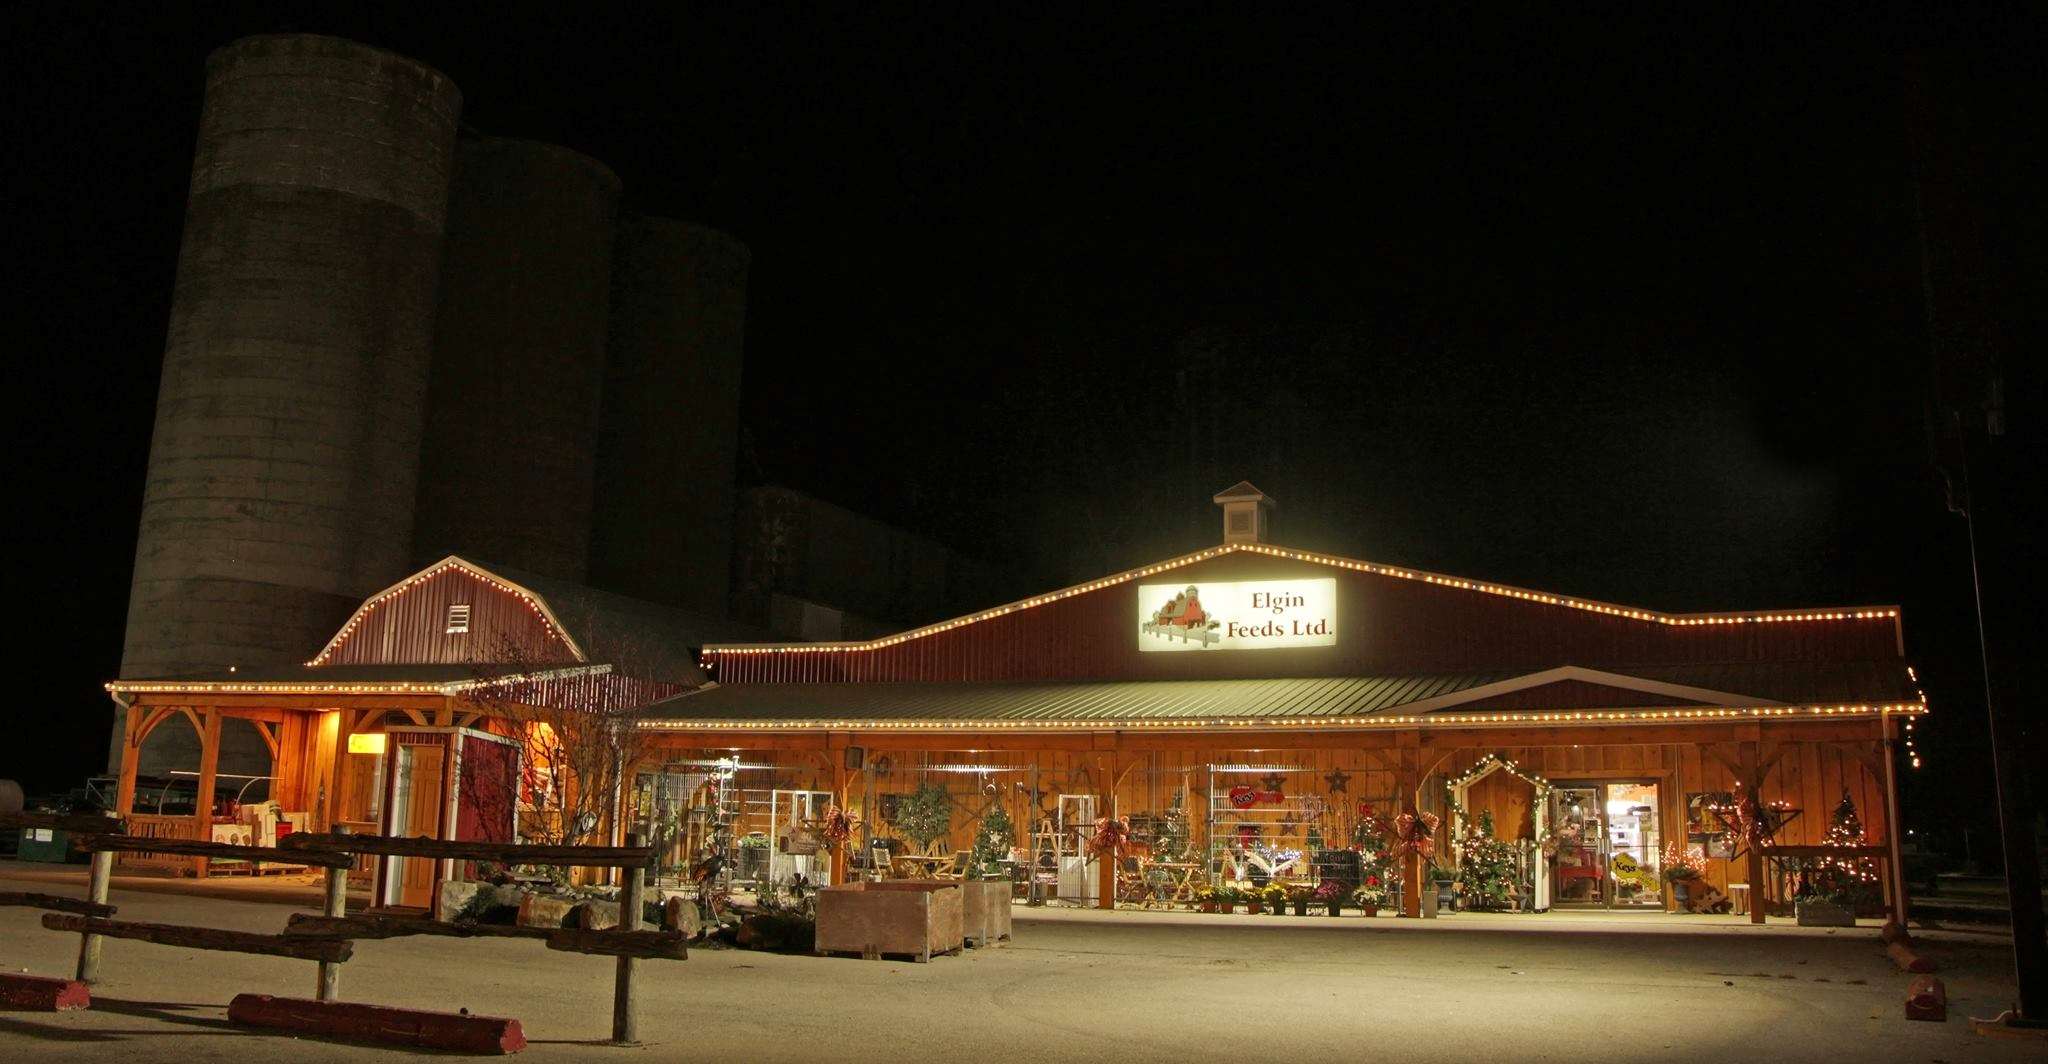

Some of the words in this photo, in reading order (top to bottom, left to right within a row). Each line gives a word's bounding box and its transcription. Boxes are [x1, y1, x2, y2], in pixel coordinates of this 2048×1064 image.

[1252, 591, 1304, 614] Elgin
[1227, 620, 1284, 637] Feeds
[1292, 619, 1333, 636] Ltd.
[1616, 861, 1638, 873] Keys
